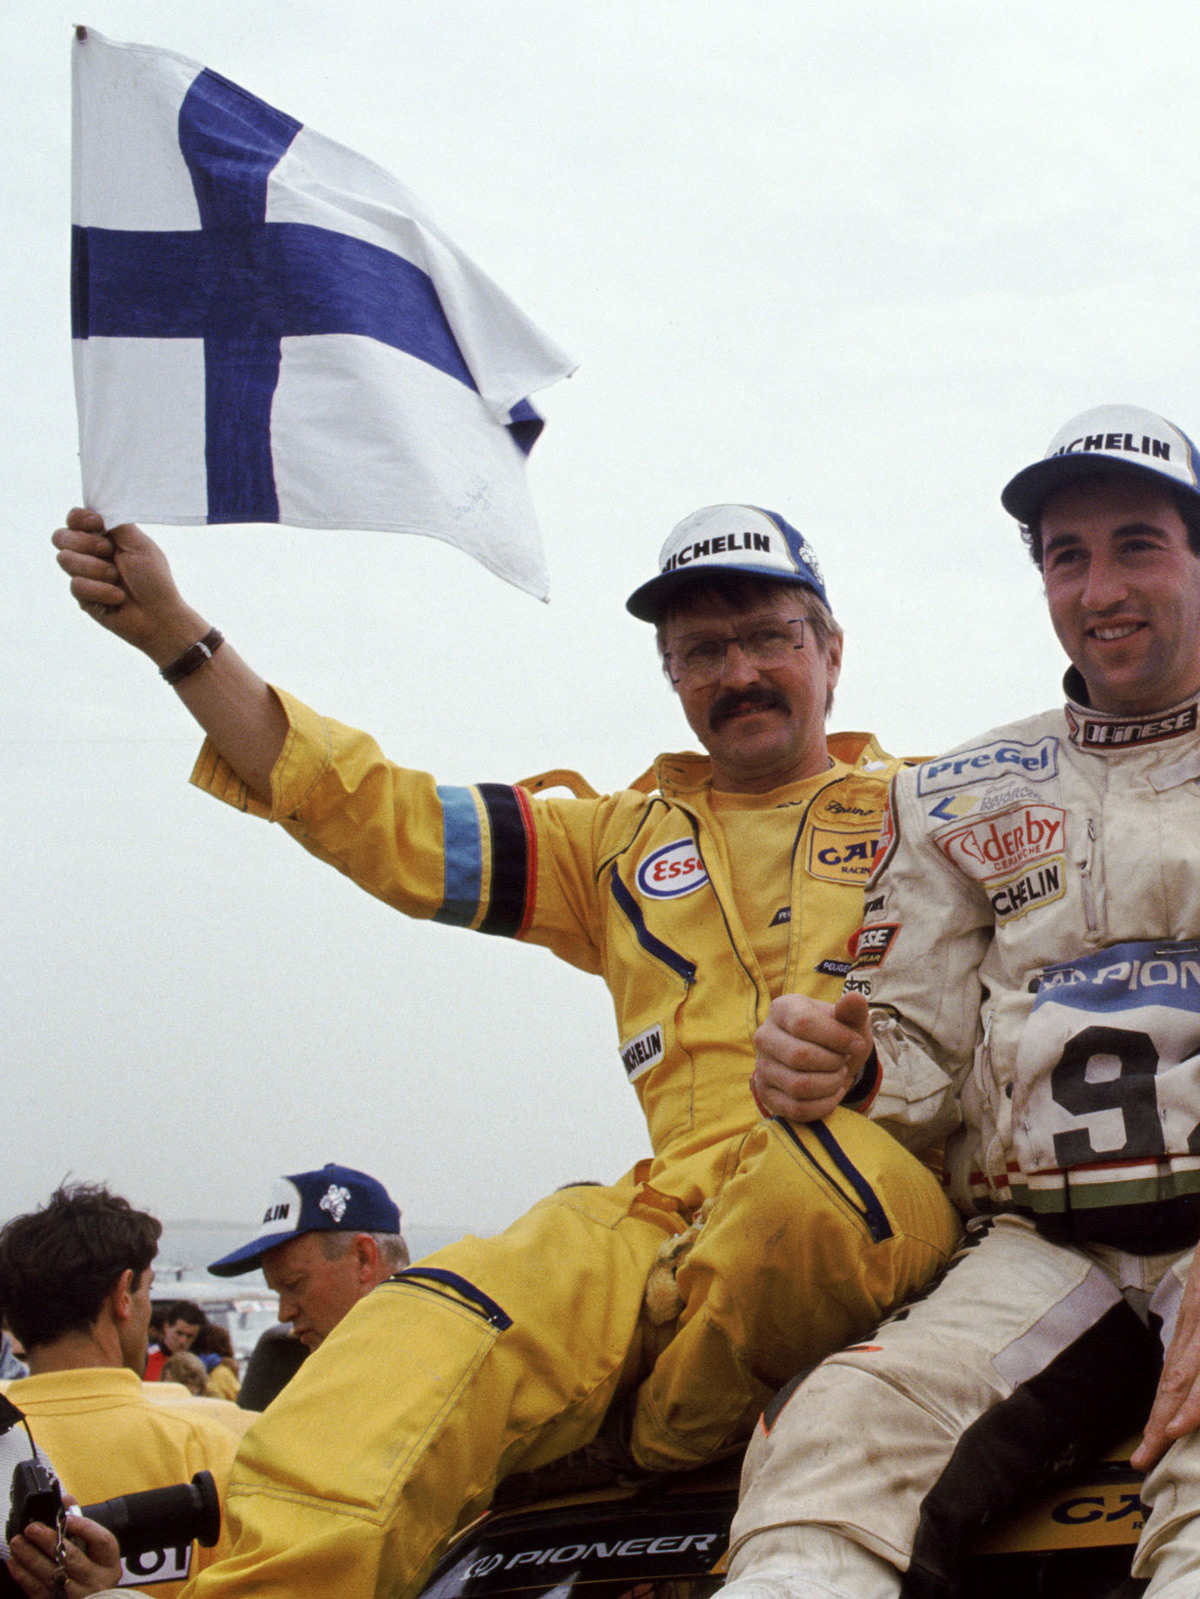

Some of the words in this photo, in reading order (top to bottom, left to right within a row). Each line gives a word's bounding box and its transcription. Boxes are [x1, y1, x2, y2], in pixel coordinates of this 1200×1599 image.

[1053, 433, 1171, 462] ICHELIN
[823, 962, 851, 973] PEUGE
[503, 1533, 718, 1570] PIONEER
